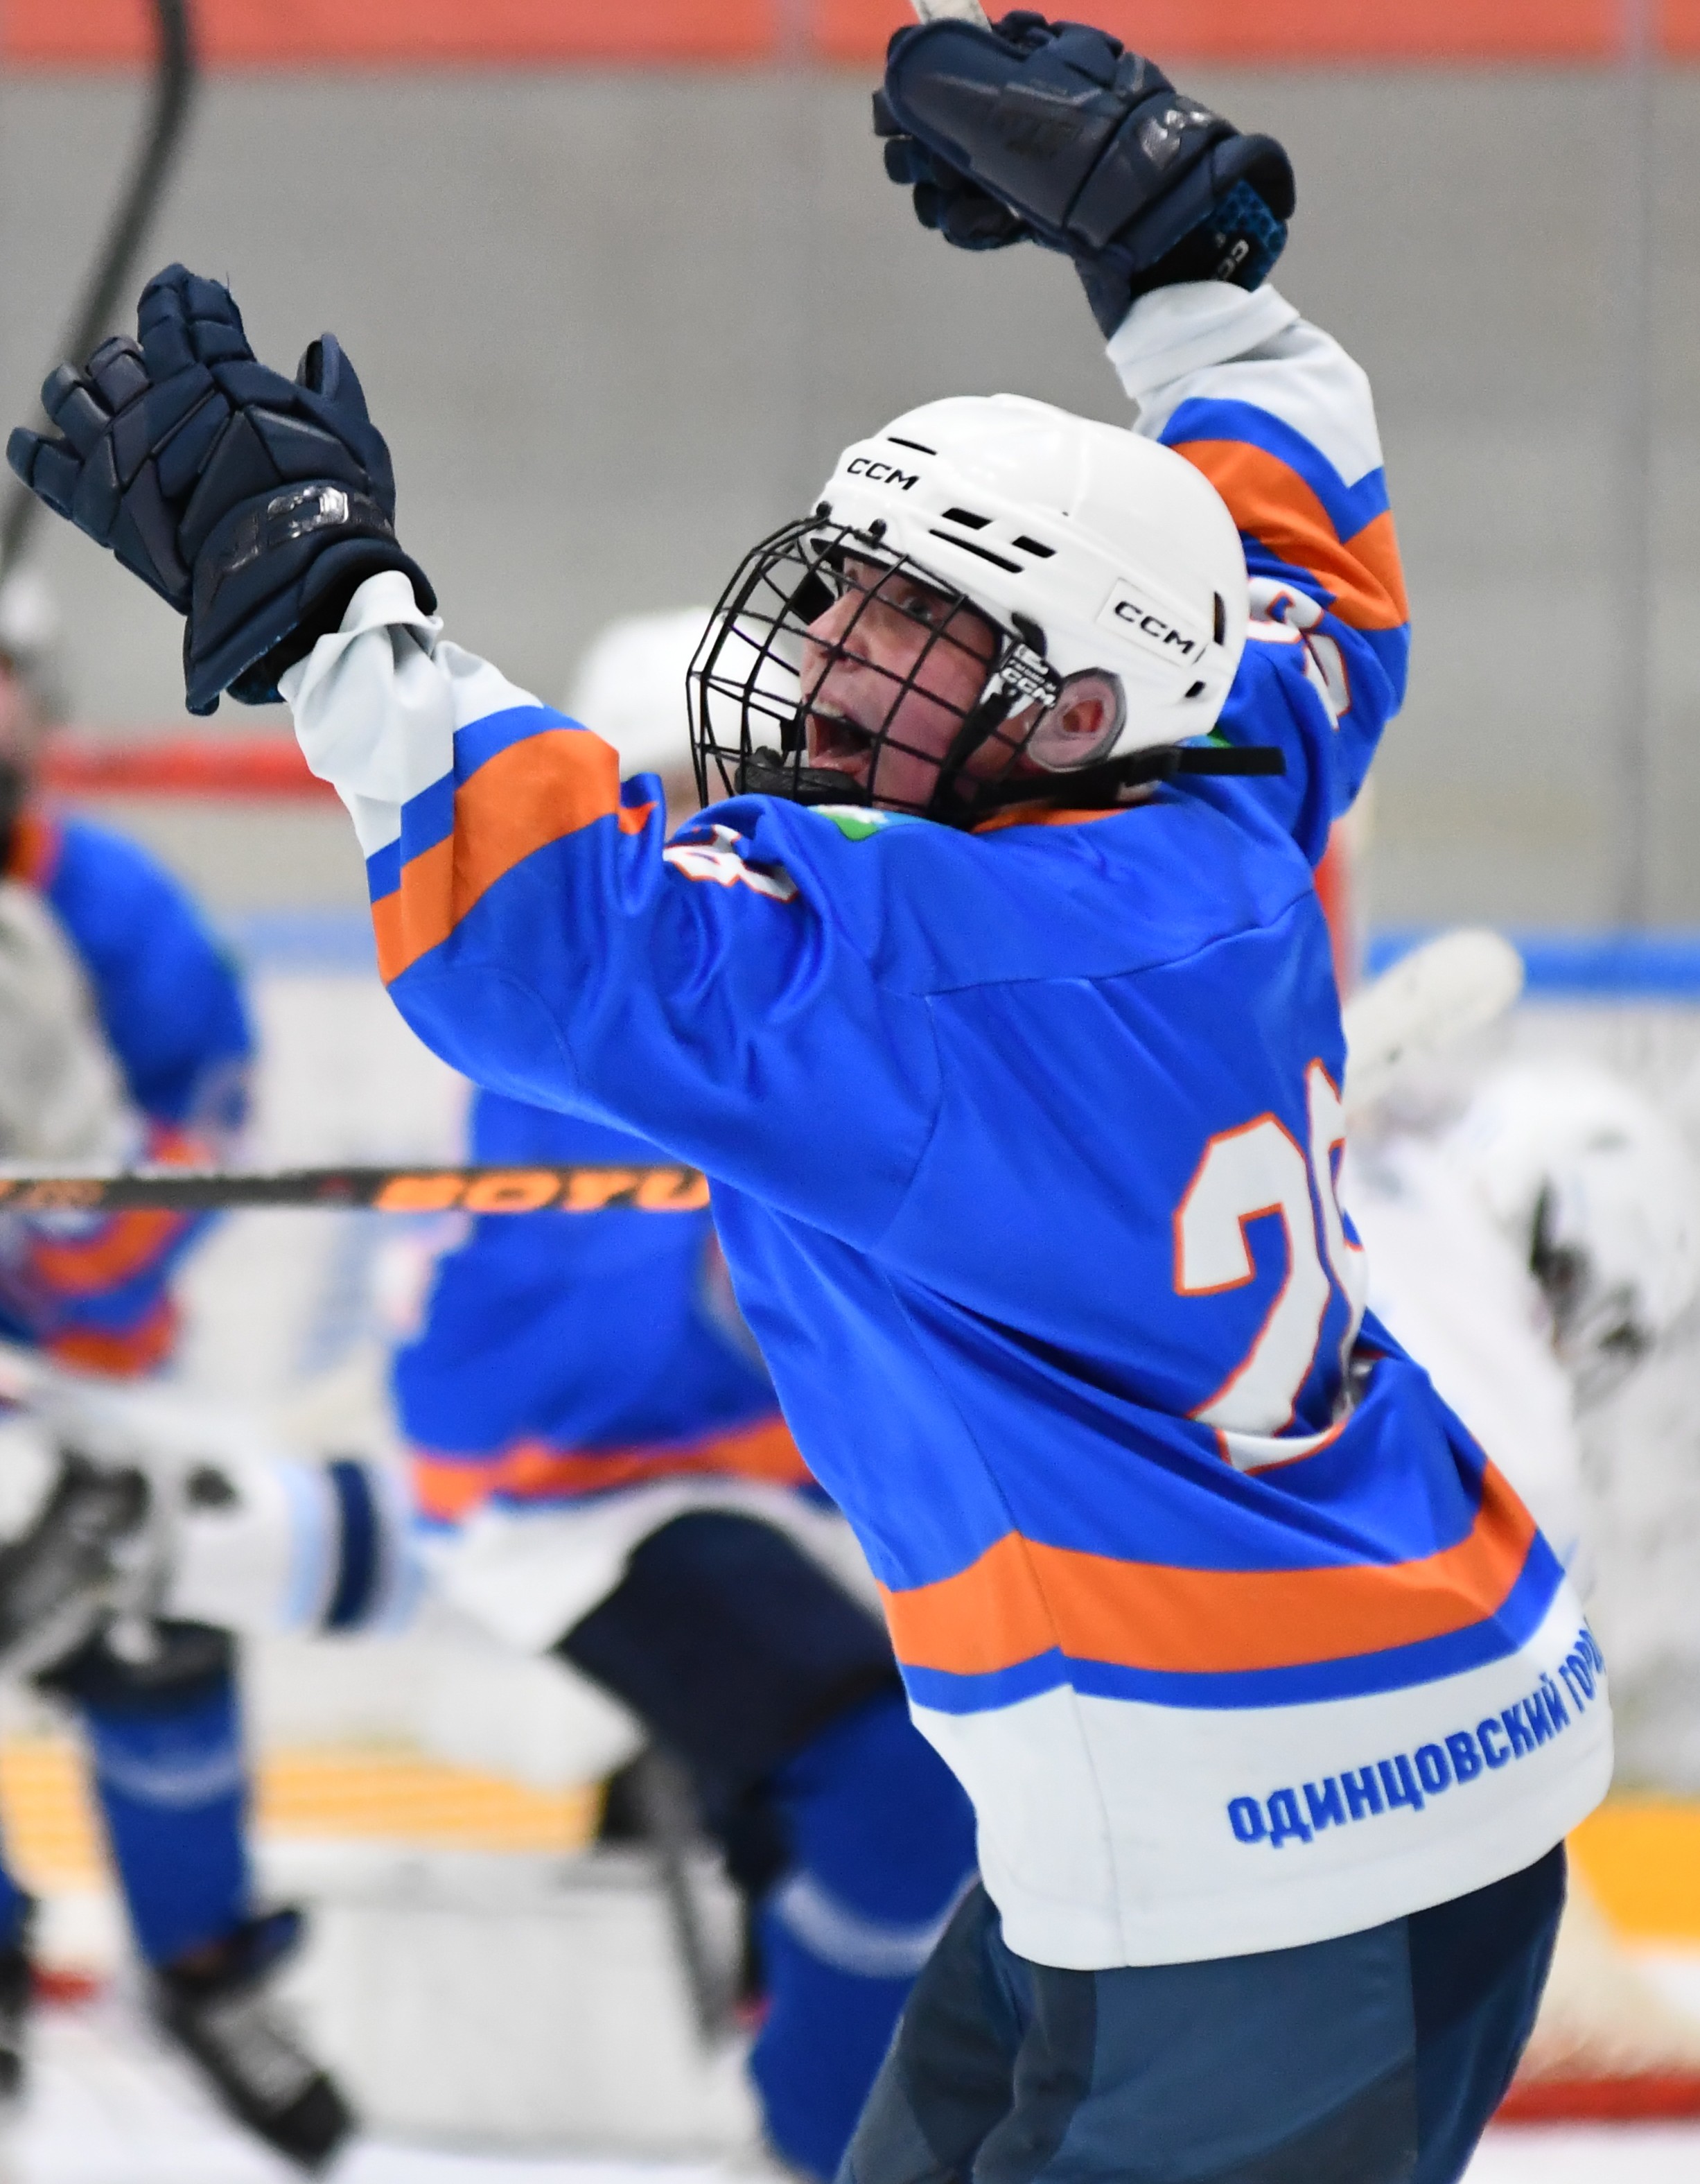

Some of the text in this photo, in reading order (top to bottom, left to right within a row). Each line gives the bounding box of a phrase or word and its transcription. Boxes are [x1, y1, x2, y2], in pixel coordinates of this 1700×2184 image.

[847, 457, 920, 491] CCM
[1114, 601, 1195, 654] CCM
[1001, 667, 1056, 707] CCM
[1227, 1672, 1570, 1849] ОДИНЦОВСКИЙ
